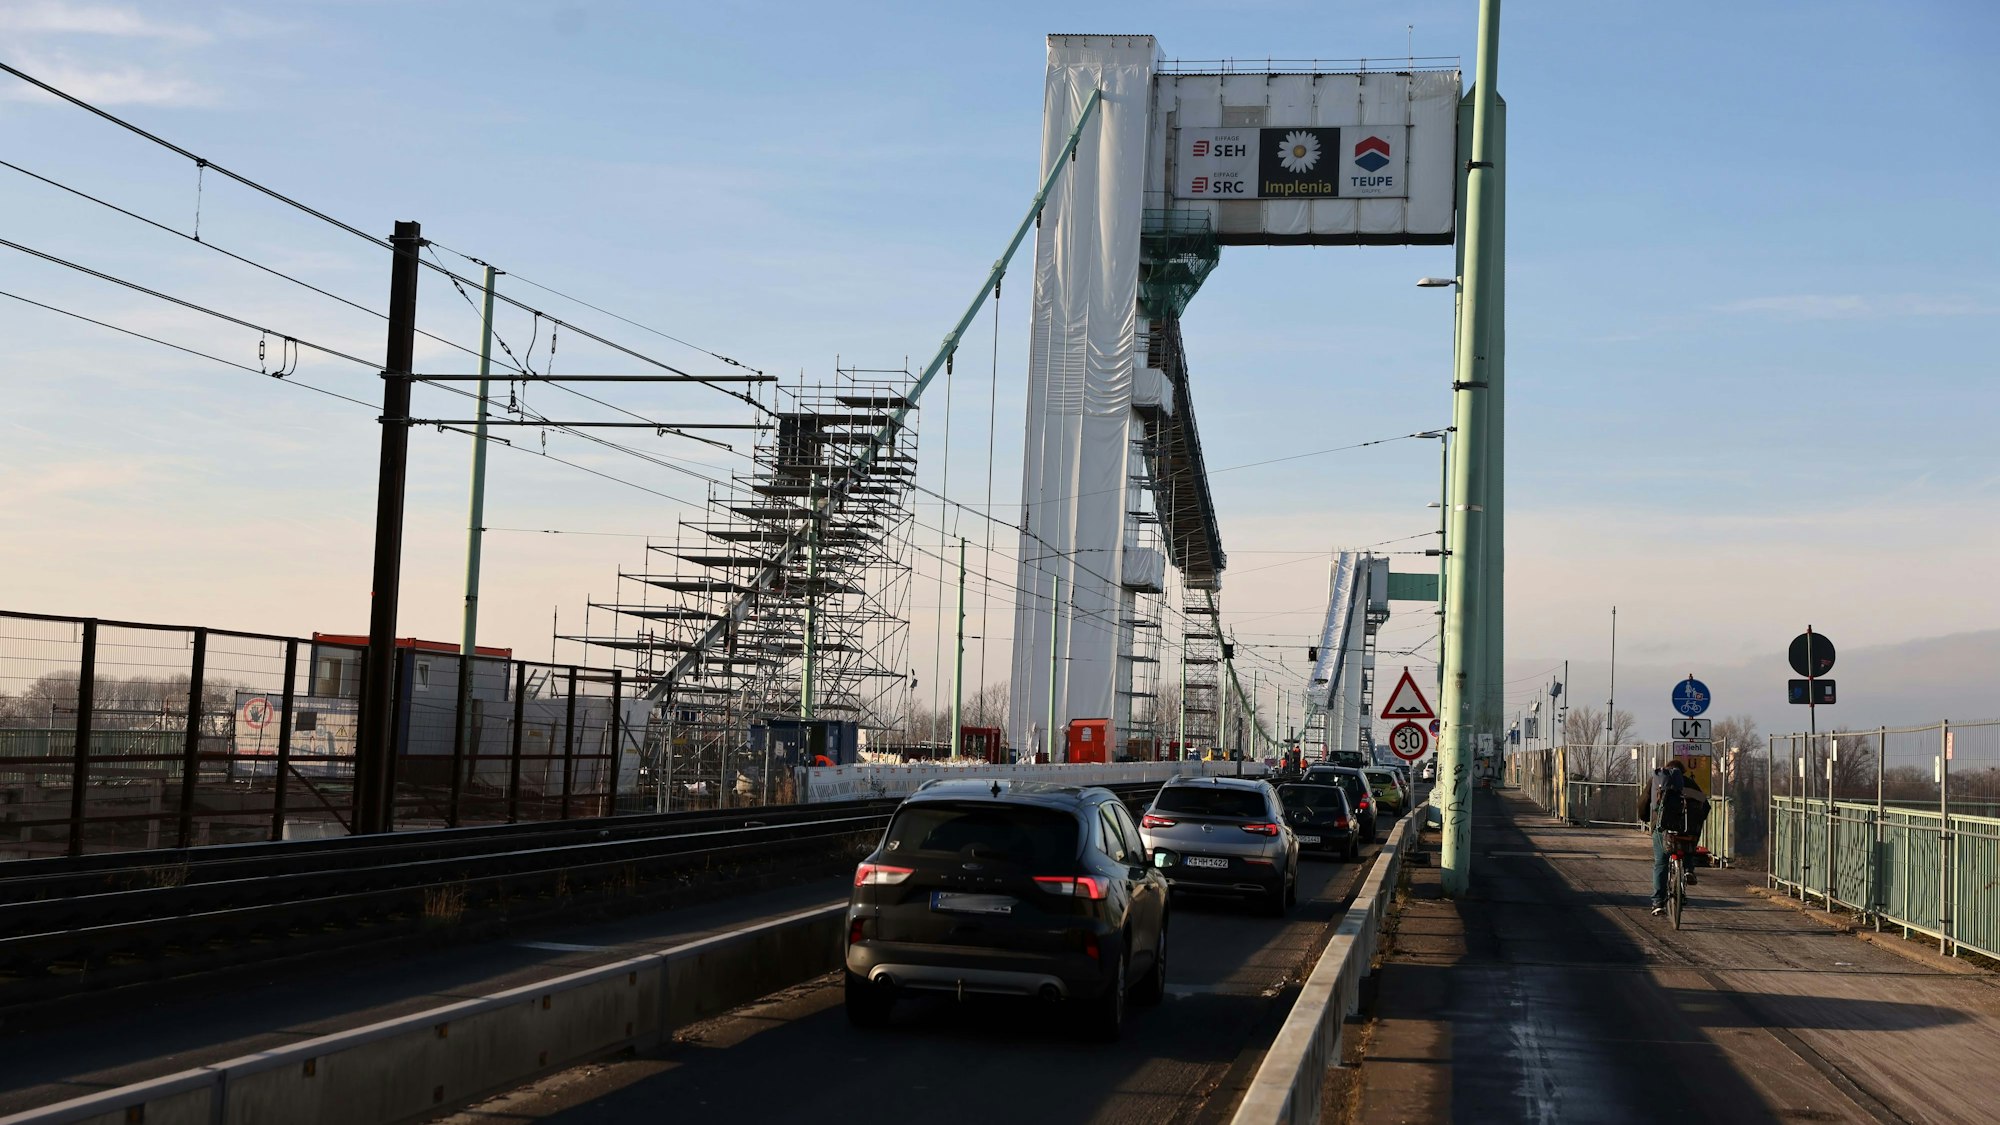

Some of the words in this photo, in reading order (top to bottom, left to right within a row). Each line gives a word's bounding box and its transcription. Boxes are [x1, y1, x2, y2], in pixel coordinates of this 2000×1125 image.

[1214, 144, 1246, 157] SEH
[1212, 181, 1245, 193] SRC
[1351, 176, 1393, 187] TEUPE
[1265, 179, 1332, 197] Implenia
[1397, 732, 1419, 749] 30
[1688, 758, 1697, 769] U
